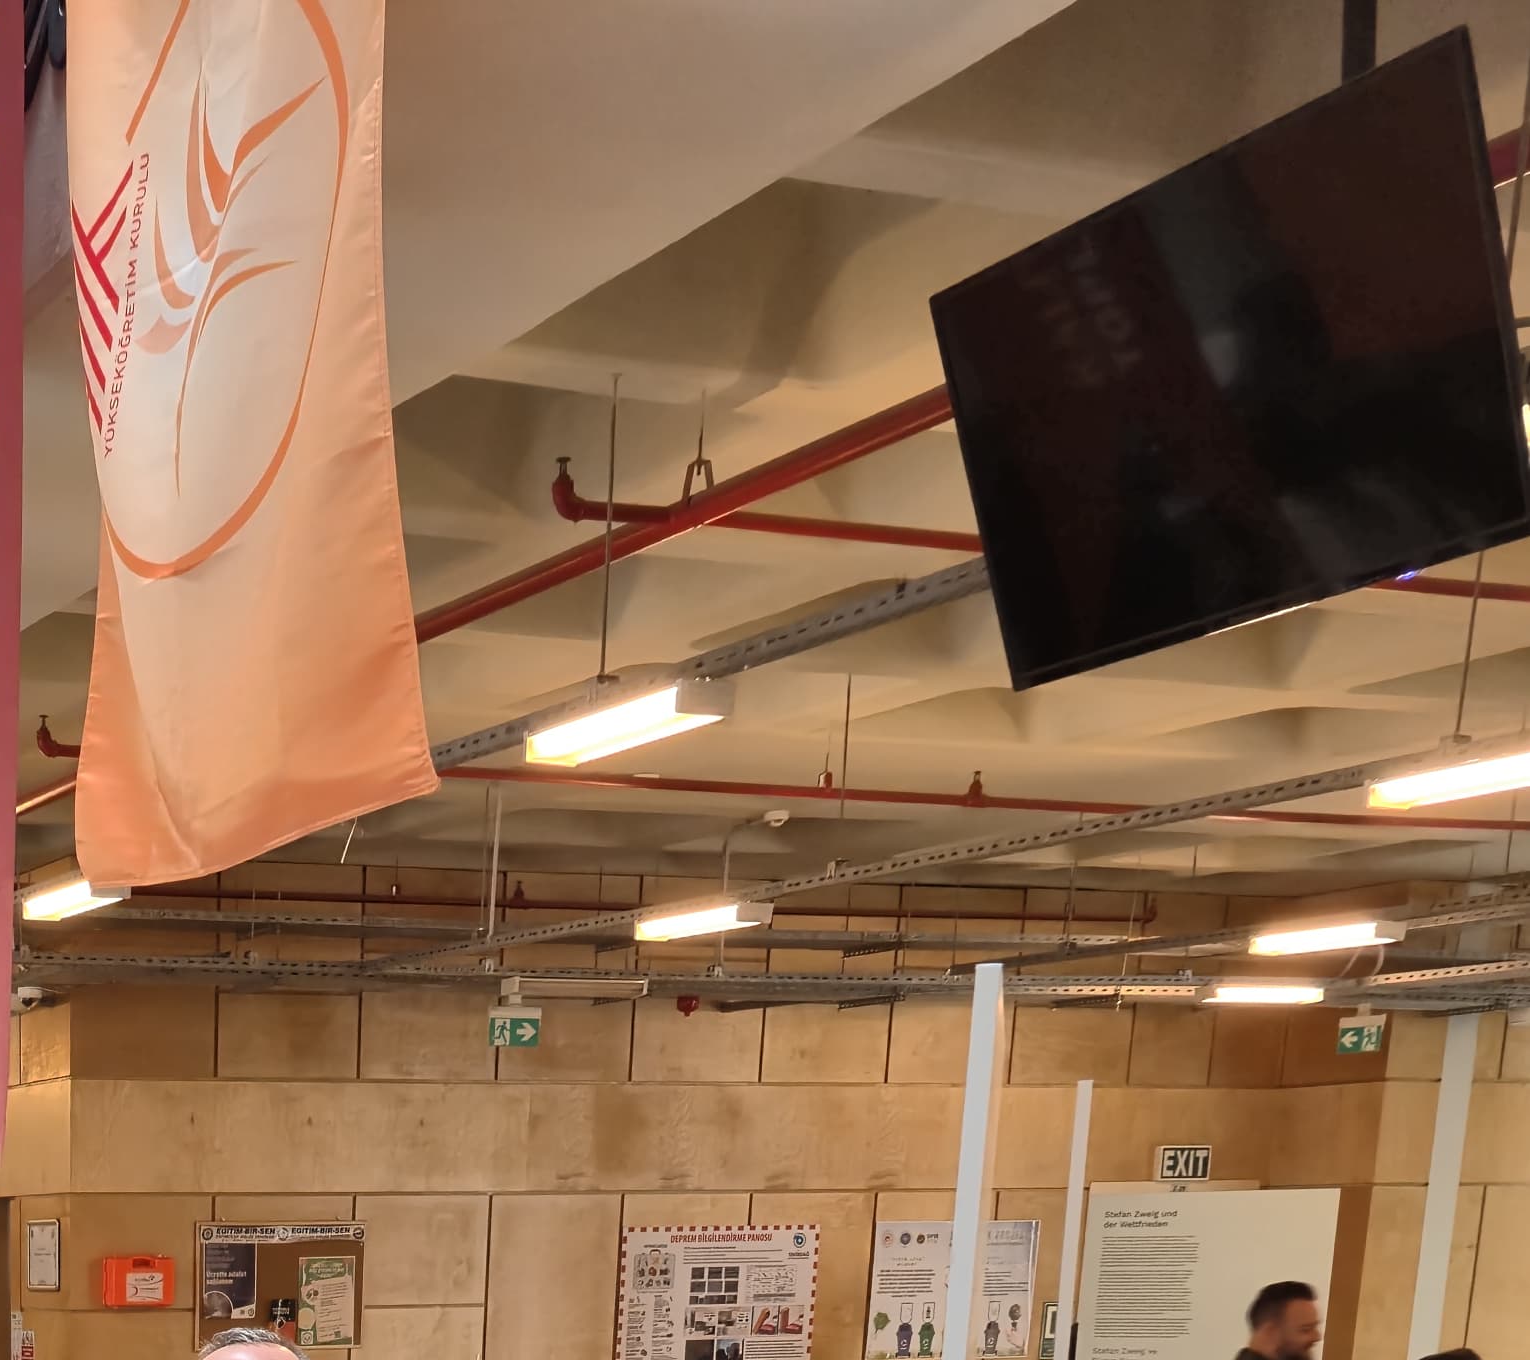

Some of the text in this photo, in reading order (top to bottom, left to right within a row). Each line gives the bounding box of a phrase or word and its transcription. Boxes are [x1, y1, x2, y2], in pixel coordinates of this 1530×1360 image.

[104, 153, 150, 459] YÜKSEKÖĞRETİM KURULU
[1162, 1150, 1208, 1176] EXIT
[670, 1234, 697, 1243] DEPREM
[747, 1233, 773, 1242] PANOSU
